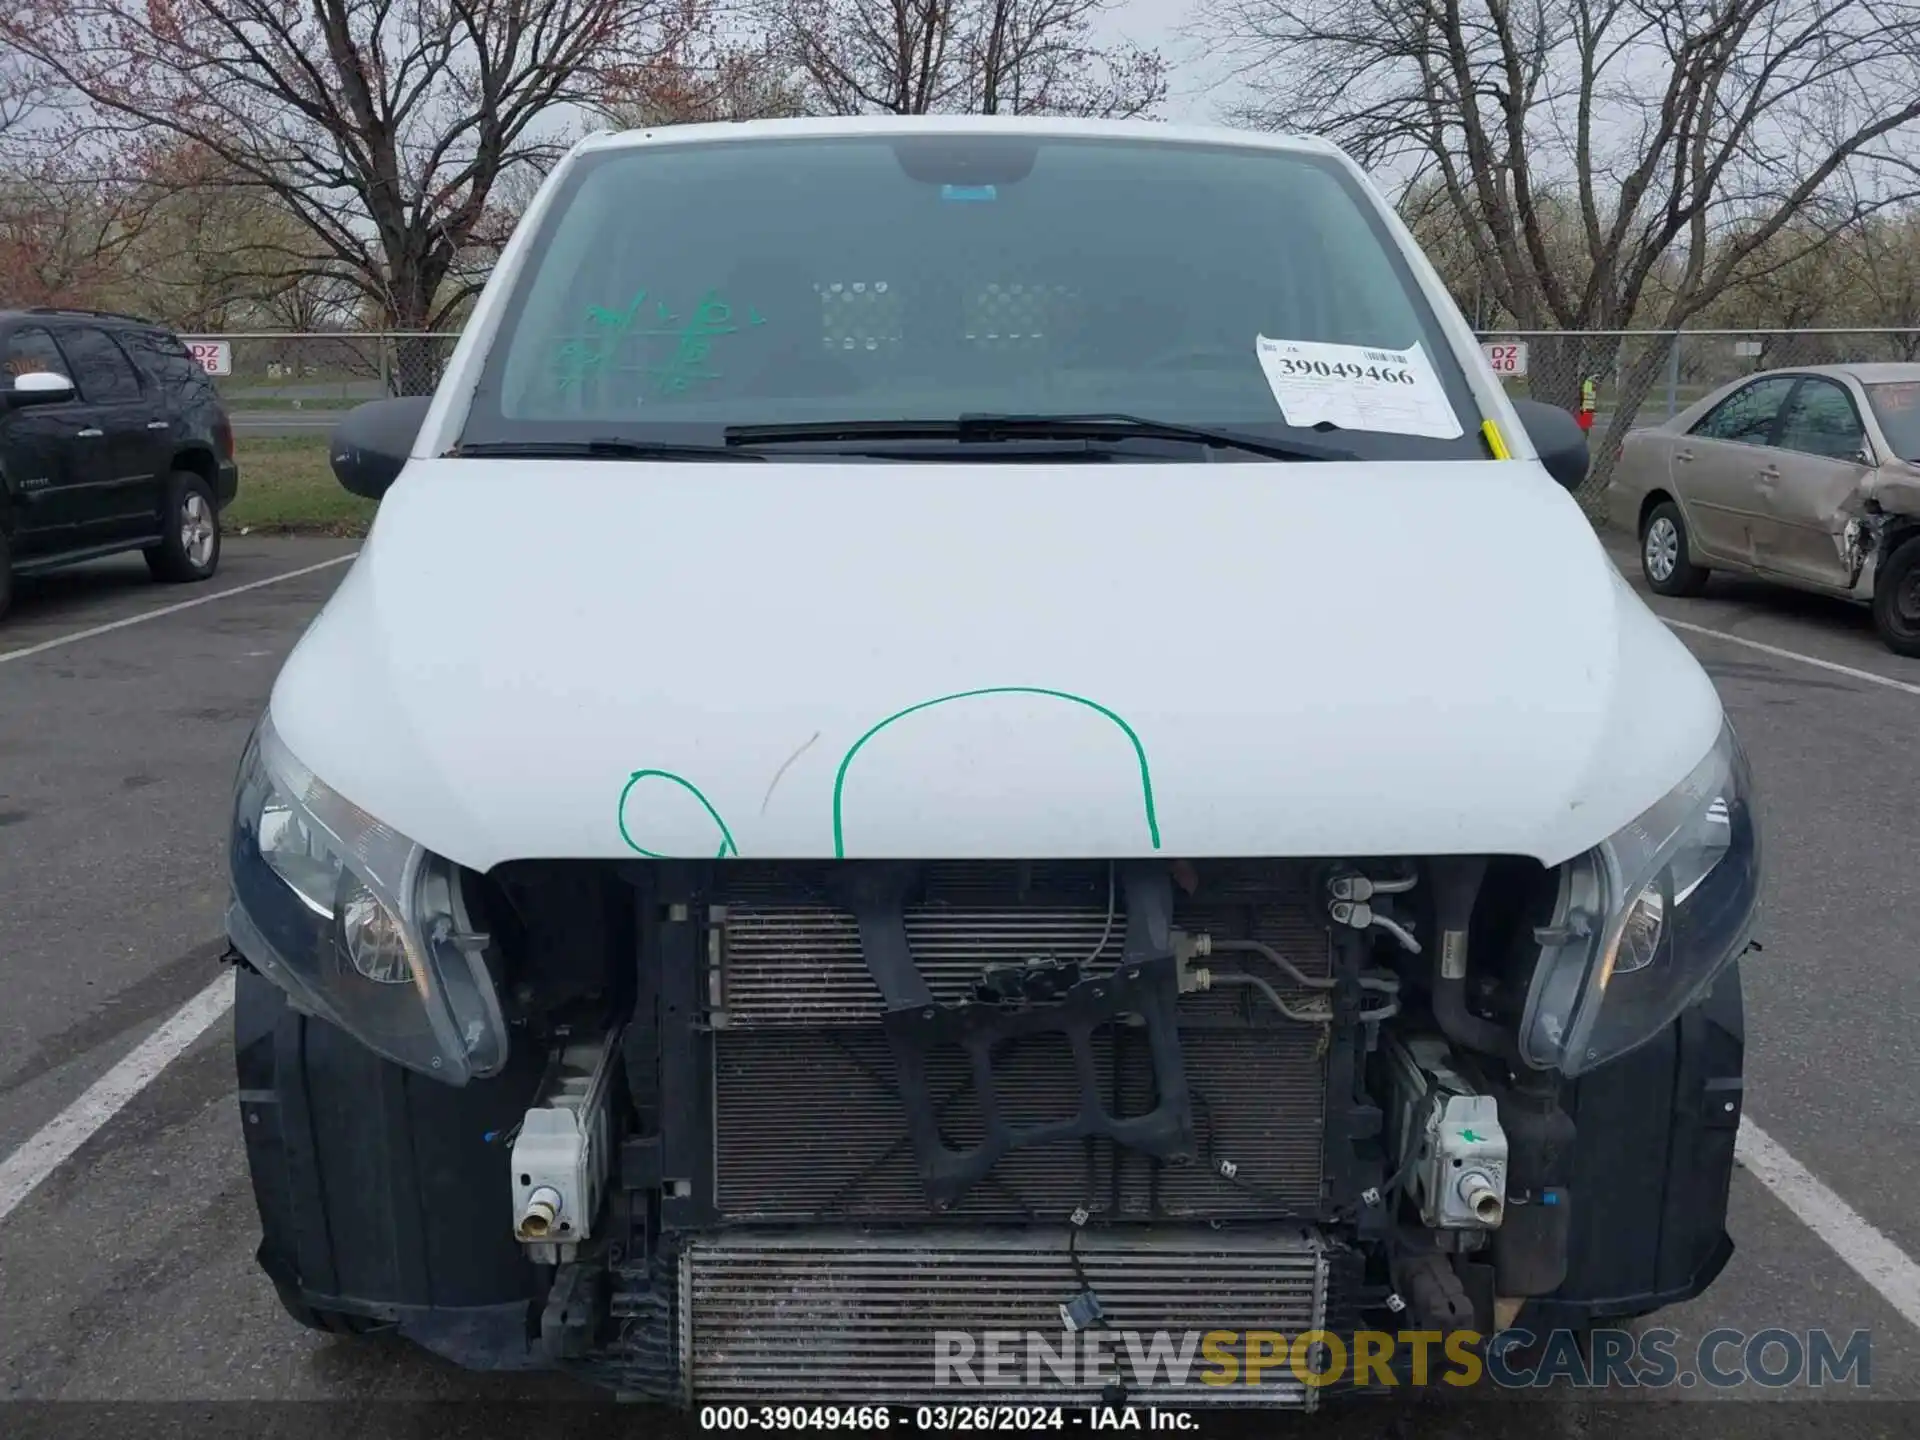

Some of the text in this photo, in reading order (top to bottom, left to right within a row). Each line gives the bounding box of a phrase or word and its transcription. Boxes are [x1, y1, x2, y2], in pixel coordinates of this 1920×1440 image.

[192, 345, 218, 357] DZ
[1491, 346, 1517, 358] DZ
[1491, 359, 1515, 371] 40
[1279, 358, 1415, 385] 39049466
